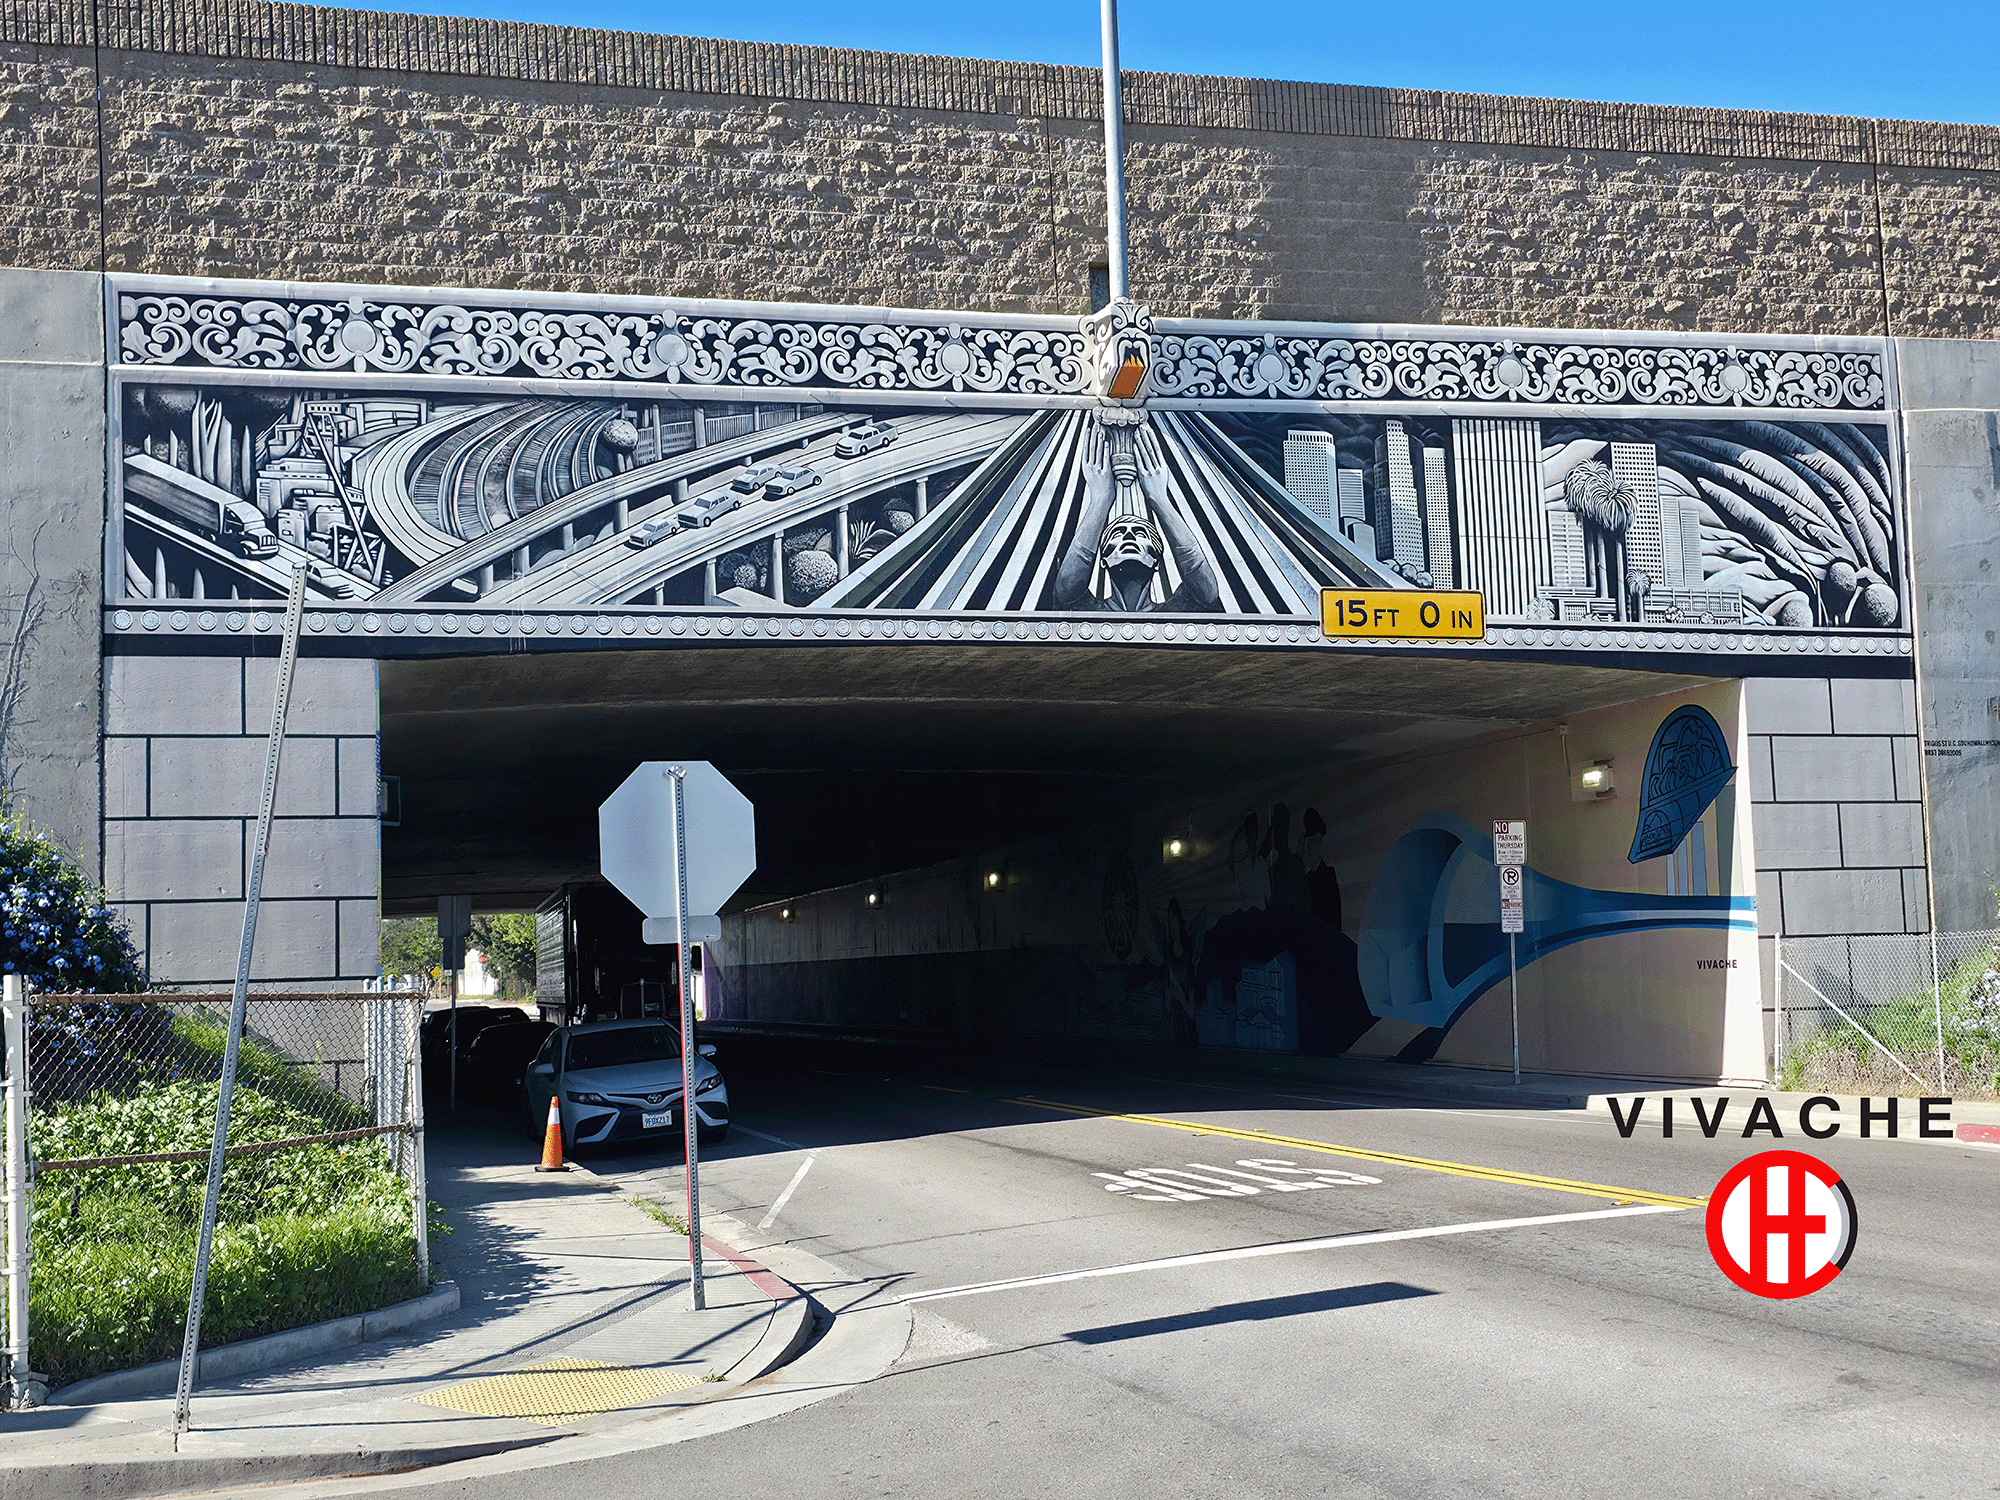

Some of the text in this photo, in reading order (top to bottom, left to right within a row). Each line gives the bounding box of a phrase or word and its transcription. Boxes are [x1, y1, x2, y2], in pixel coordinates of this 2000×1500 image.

[1335, 599, 1473, 629] 15 FT 0 IN
[1495, 821, 1508, 833] NO
[1696, 959, 1738, 970] VIVACHE
